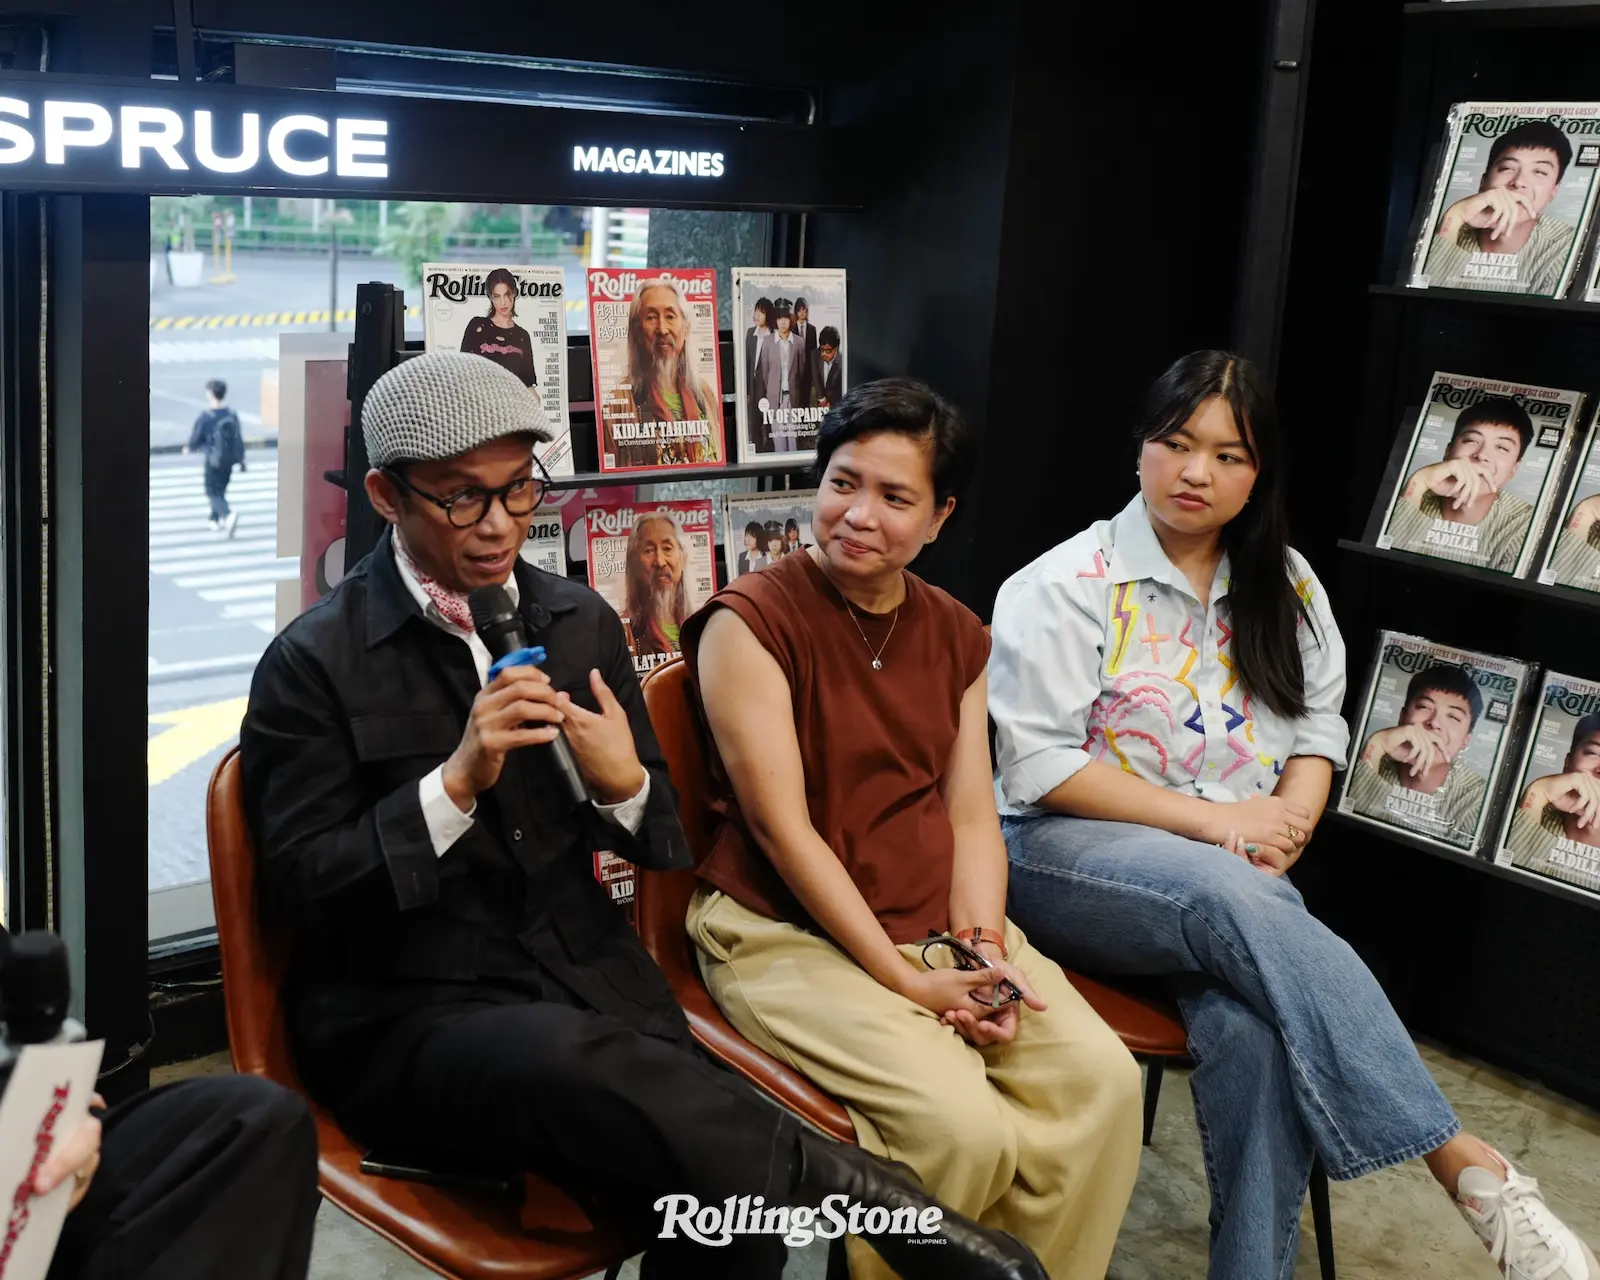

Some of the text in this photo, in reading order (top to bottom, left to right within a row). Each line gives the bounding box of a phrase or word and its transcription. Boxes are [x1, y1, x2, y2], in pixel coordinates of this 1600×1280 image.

[1482, 107, 1503, 115] GUILTY
[1503, 107, 1536, 115] PLEASURE
[0, 97, 388, 178] SPRUCE
[573, 146, 725, 177] MAGAZINES
[1470, 251, 1519, 267] DANIEL
[1462, 264, 1518, 280] PADILLA
[596, 303, 629, 320] HALL
[1438, 376, 1449, 385] THE
[1450, 378, 1471, 388] GUILTY
[1471, 381, 1501, 392] PLEASURE
[1502, 384, 1510, 393] OF
[1539, 389, 1561, 400] GOSSIP
[763, 409, 775, 425] IV
[776, 408, 790, 424] OF
[612, 420, 710, 440] KIDLAT TAHIMIK
[1431, 518, 1479, 539] DANIEL
[1424, 530, 1479, 552] PADILLA
[1421, 643, 1450, 658] PLEASURE
[632, 654, 656, 671] LAT
[1565, 681, 1587, 693] GUILTY
[1556, 835, 1600, 862] DANIE
[1549, 848, 1600, 876] PADILL
[611, 880, 635, 899] KID
